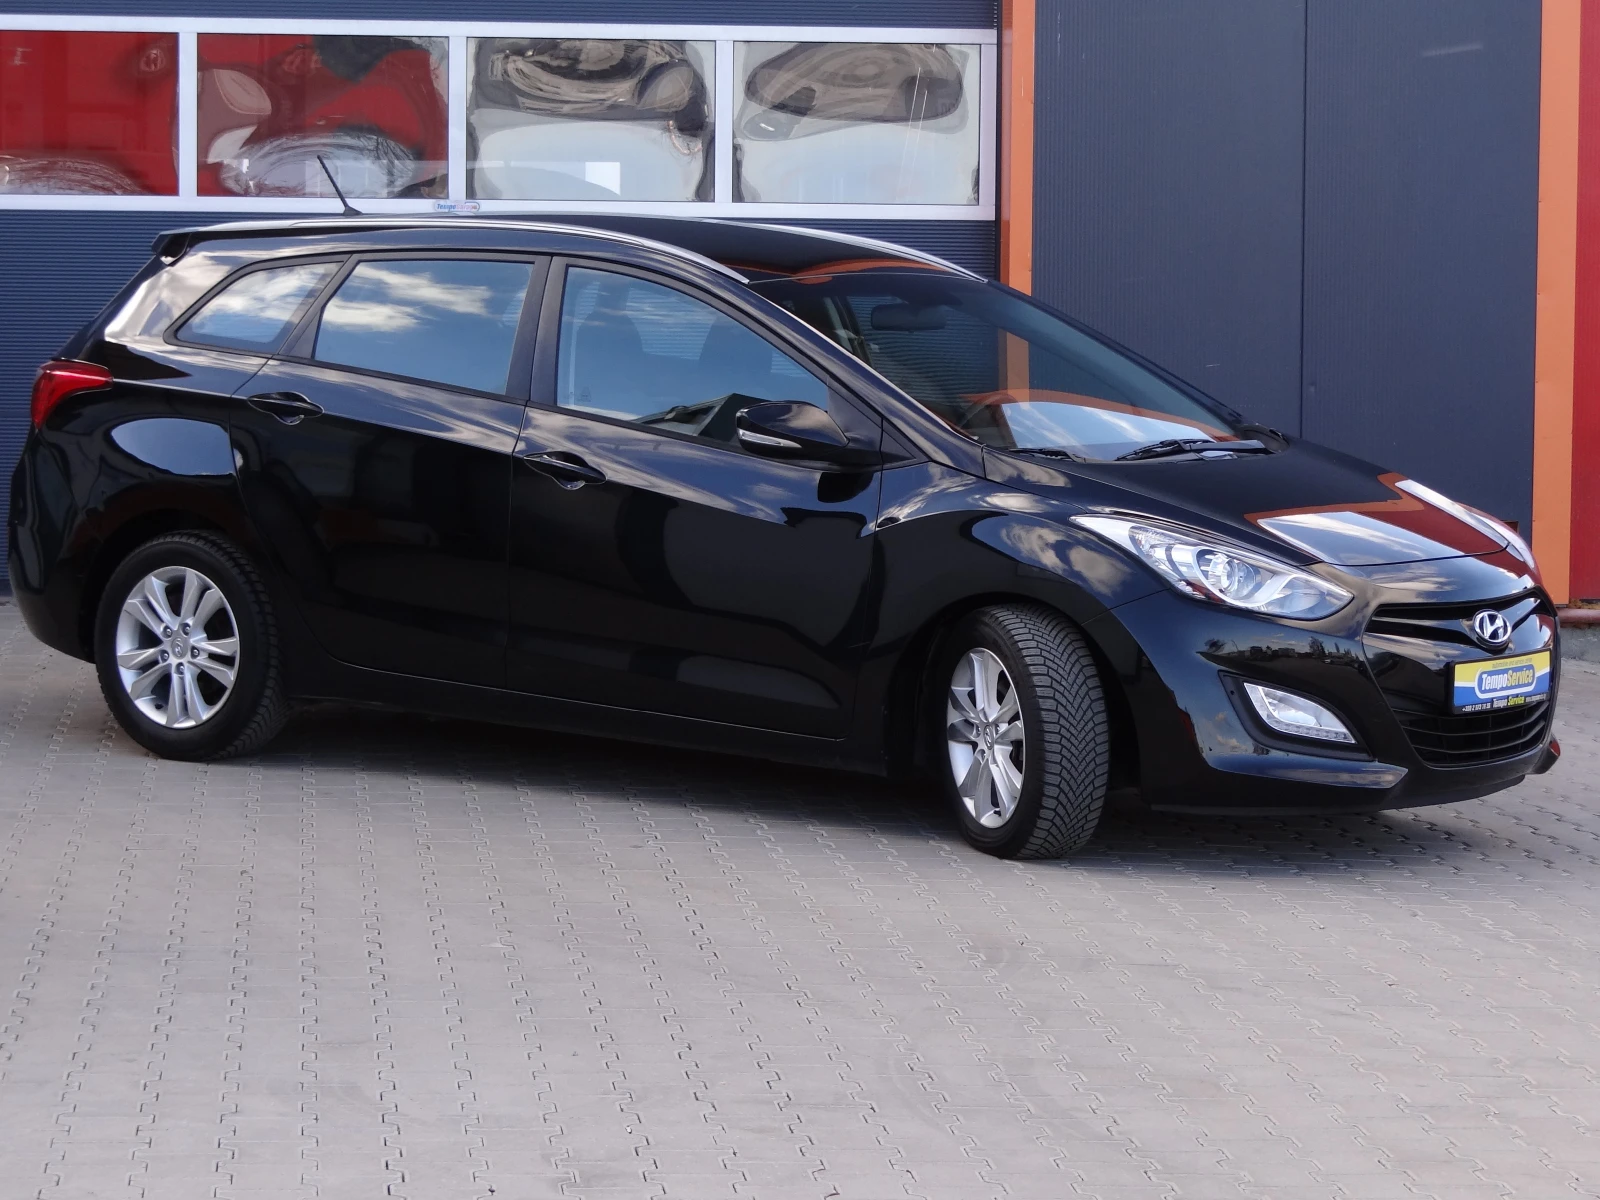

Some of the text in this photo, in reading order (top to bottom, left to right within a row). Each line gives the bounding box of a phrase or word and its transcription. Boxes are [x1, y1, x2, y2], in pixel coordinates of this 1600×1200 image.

[1481, 668, 1533, 691] TempoService
[1492, 698, 1508, 709] Tempo
[1508, 695, 1525, 706] Service
